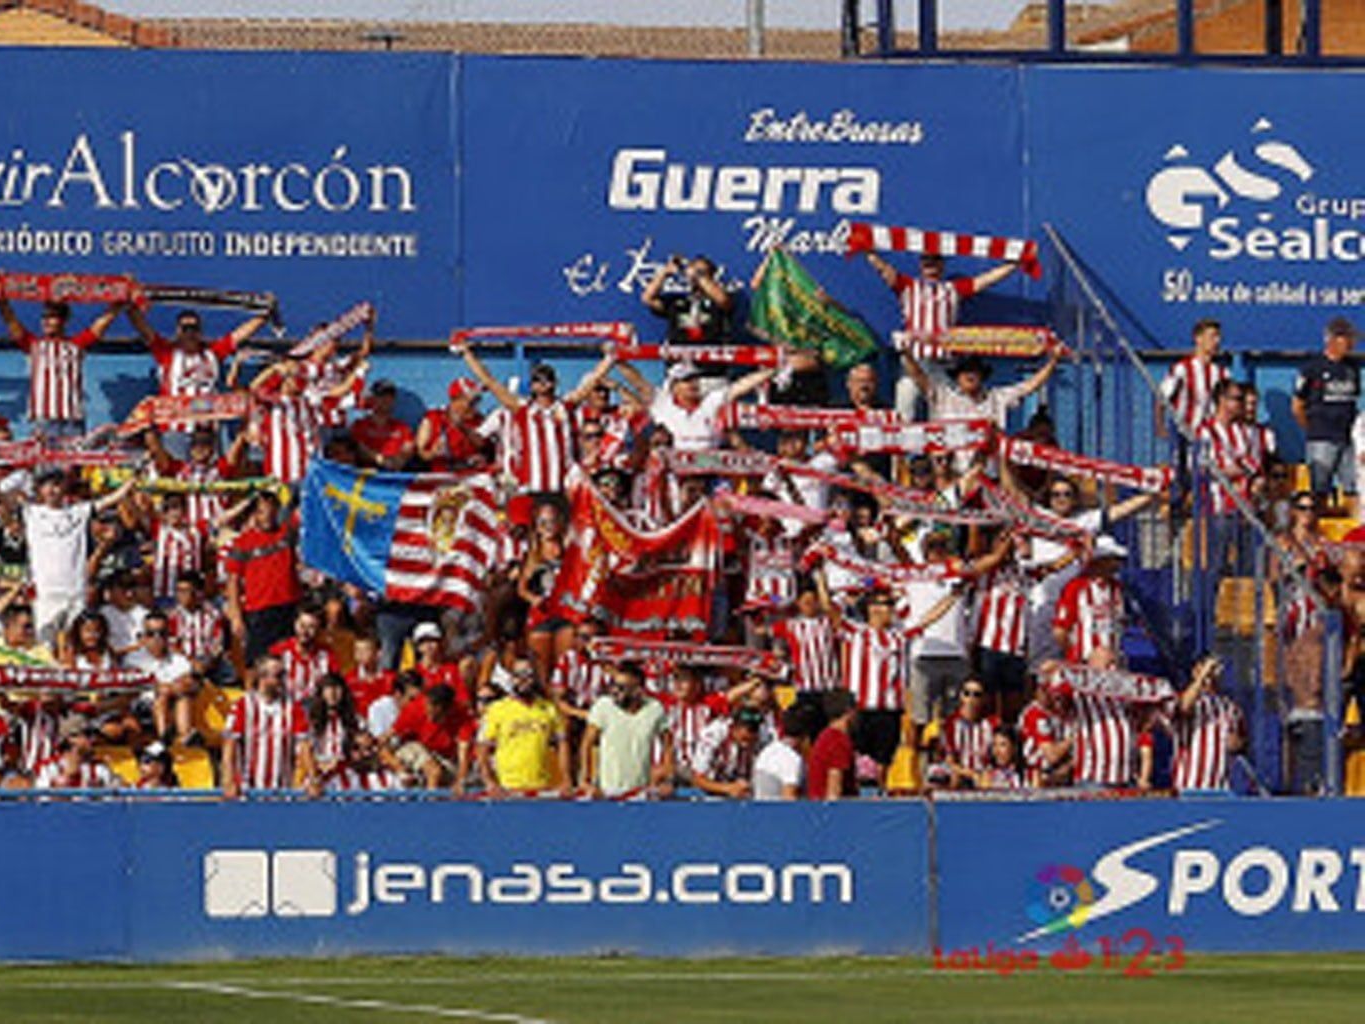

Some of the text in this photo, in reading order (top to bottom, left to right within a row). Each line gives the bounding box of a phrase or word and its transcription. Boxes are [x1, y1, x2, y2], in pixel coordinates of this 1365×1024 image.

[608, 148, 881, 214] Guerra
[103, 231, 215, 256] GRATUITO
[225, 232, 417, 258] INDEPENDIENTE
[1209, 216, 1365, 261] Sealc
[1163, 269, 1193, 302] 50
[346, 850, 853, 915] jenasa.com
